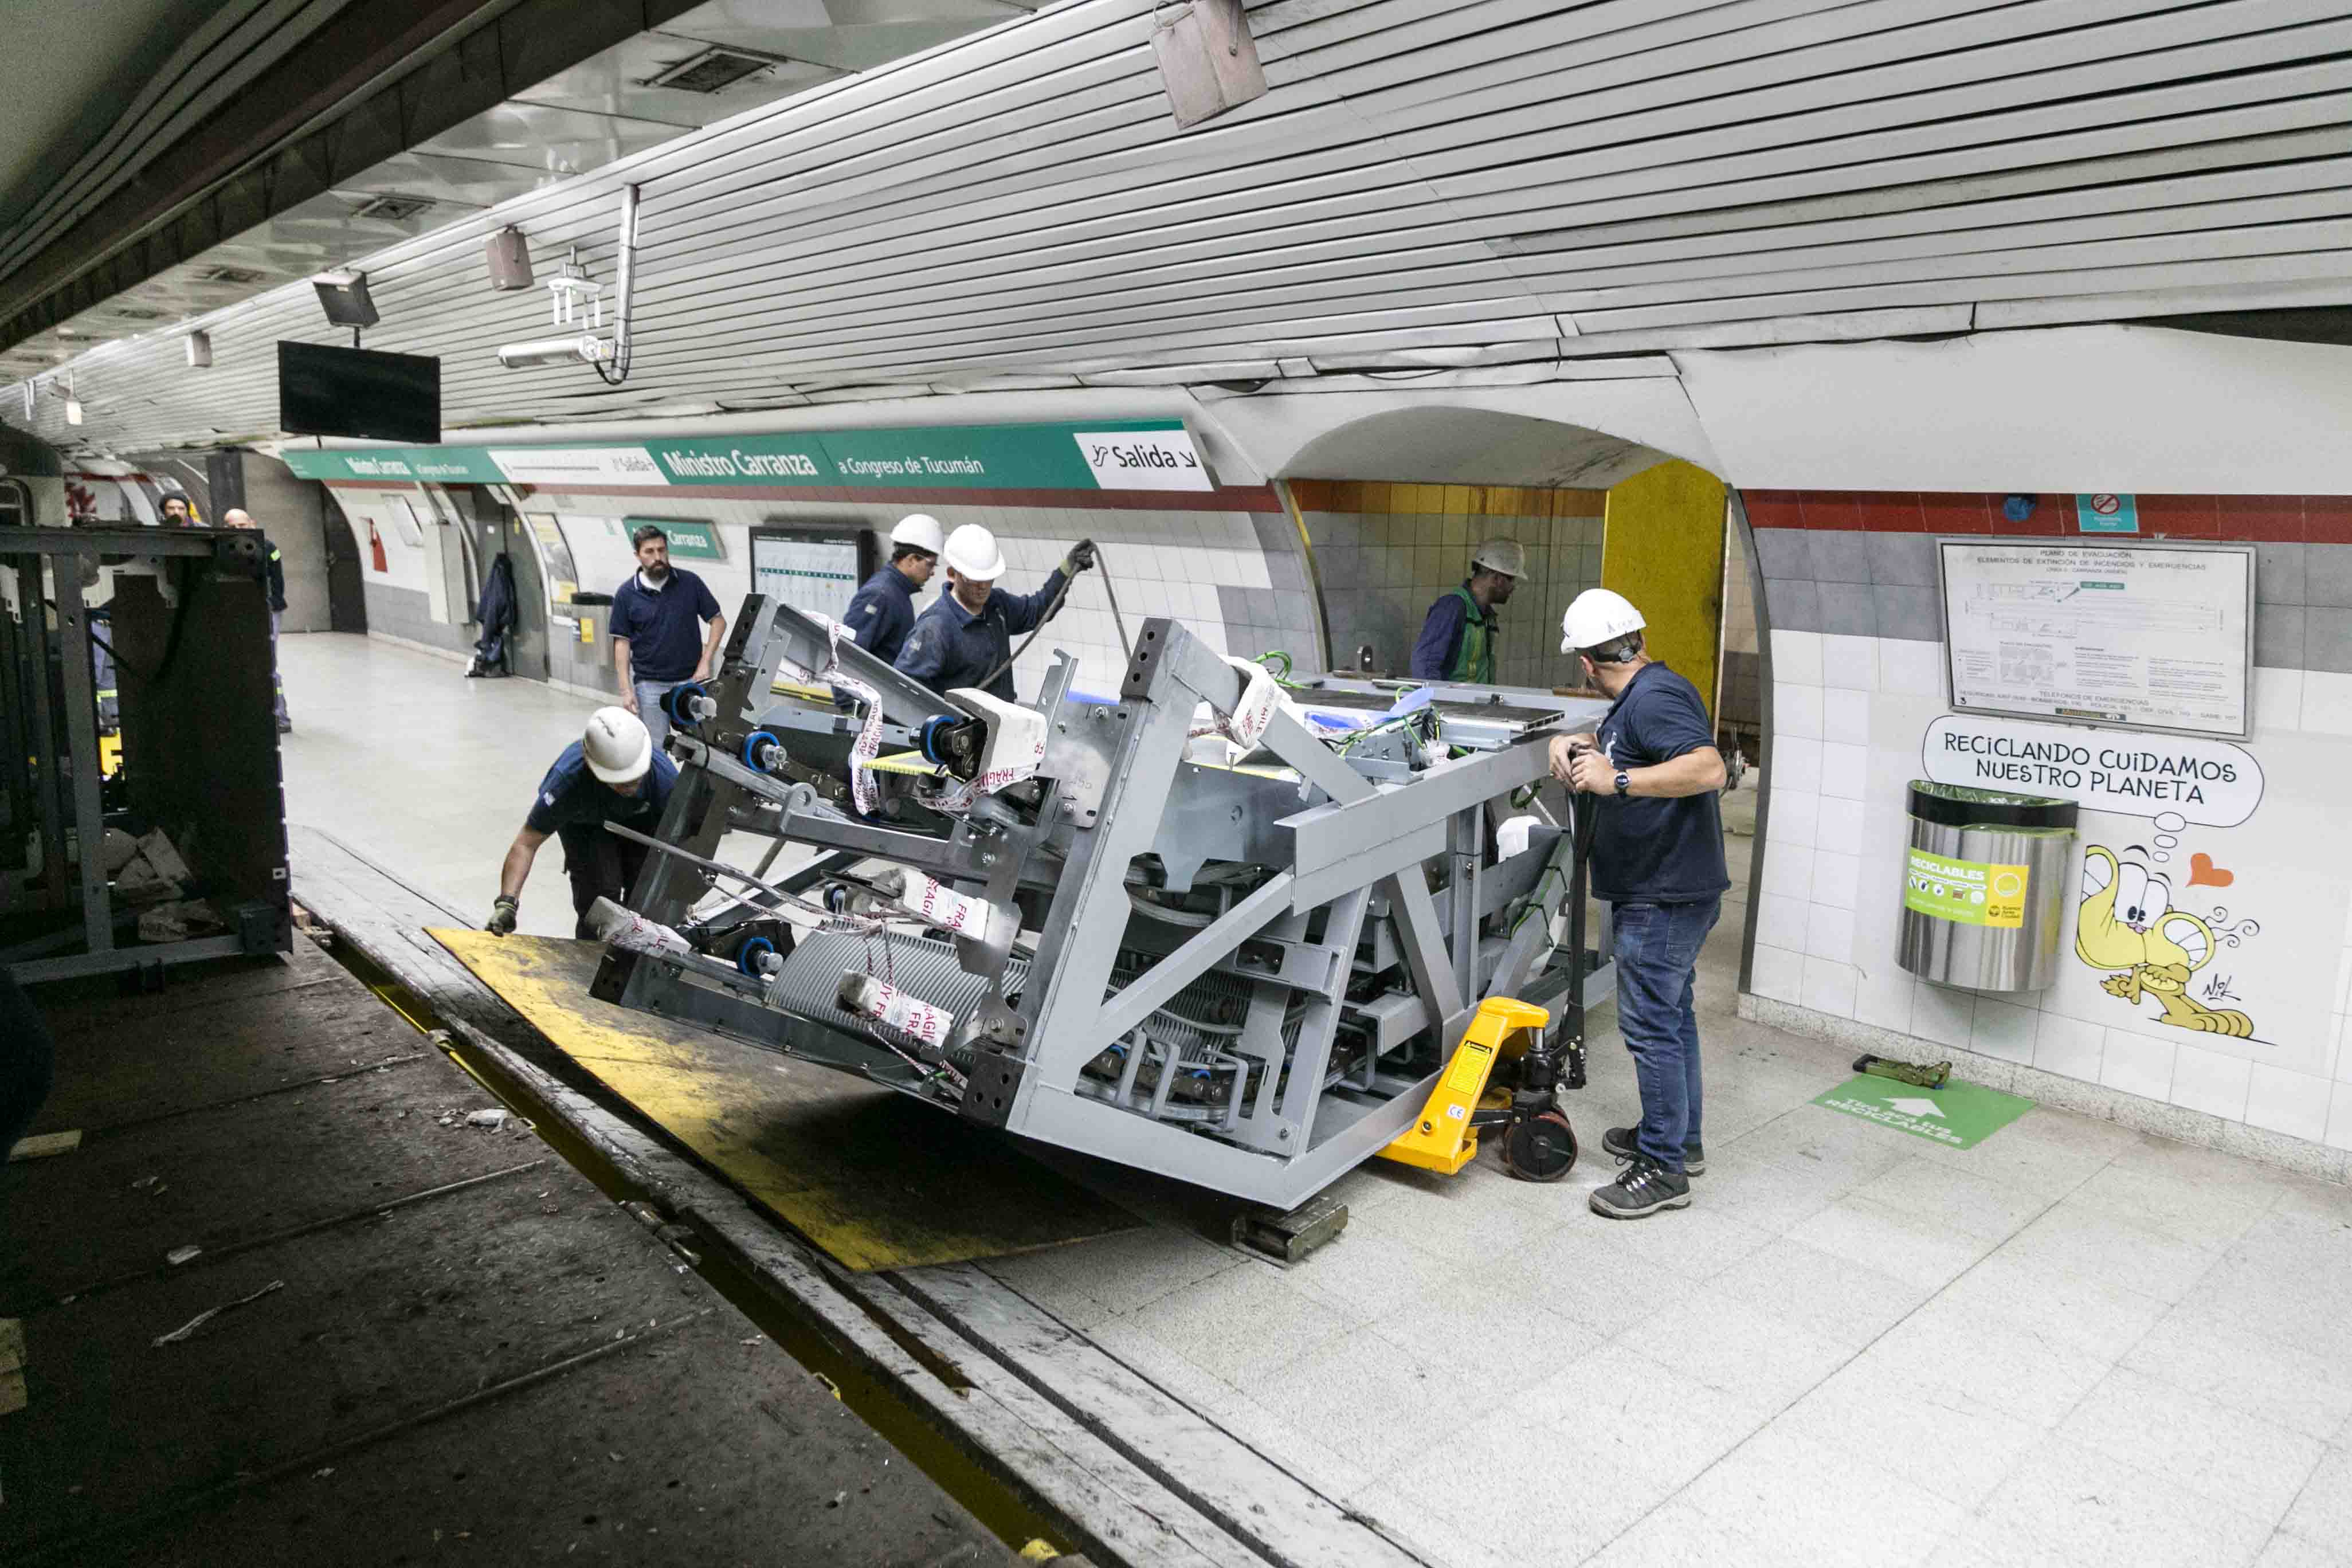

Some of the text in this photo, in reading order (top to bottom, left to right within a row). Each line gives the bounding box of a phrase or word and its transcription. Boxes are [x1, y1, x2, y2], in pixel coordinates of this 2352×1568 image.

[662, 449, 818, 476] Ministro Carranza
[838, 456, 985, 478] a Congreso de Tucumán
[1112, 444, 1178, 468] Salida
[667, 529, 708, 548] Carranza
[1977, 758, 2204, 804] NUESTRO PLANETA
[1911, 856, 1985, 880] RECICLABLES
[1449, 1106, 1464, 1118] CE
